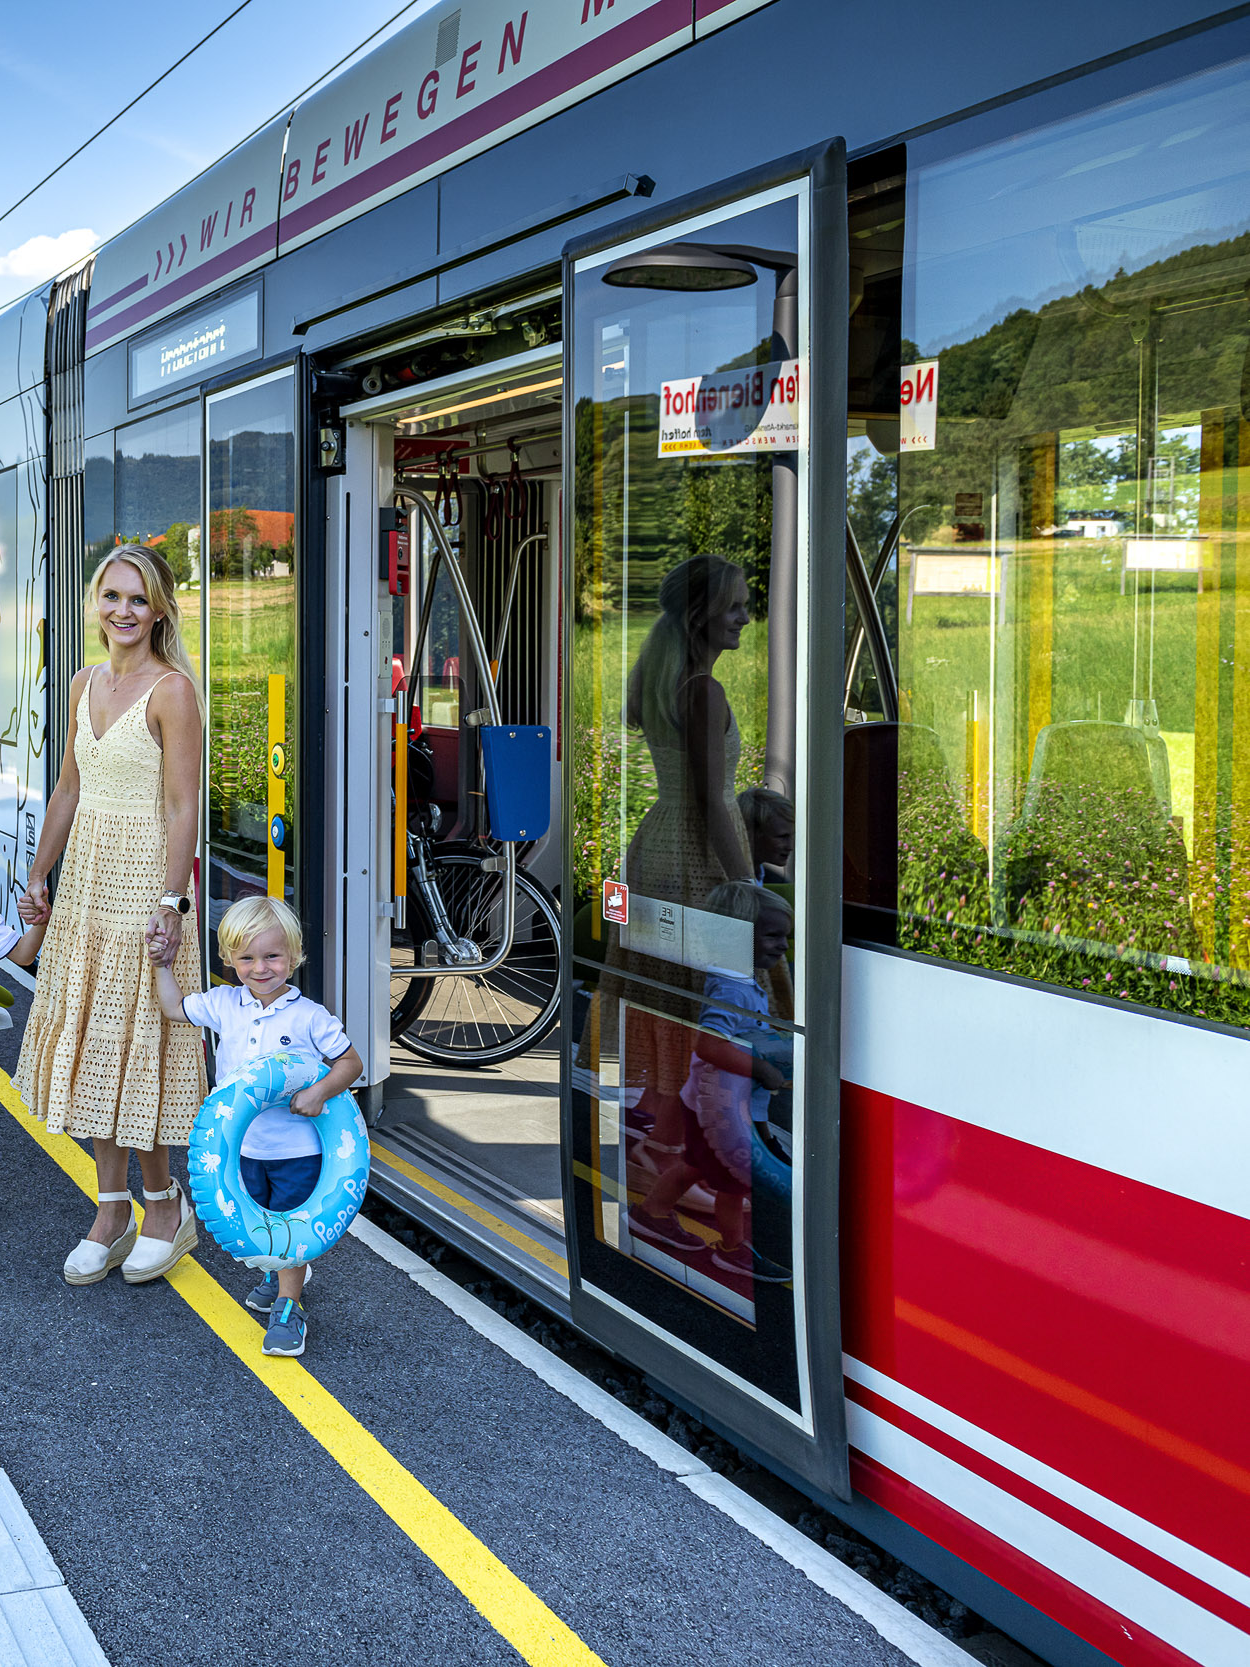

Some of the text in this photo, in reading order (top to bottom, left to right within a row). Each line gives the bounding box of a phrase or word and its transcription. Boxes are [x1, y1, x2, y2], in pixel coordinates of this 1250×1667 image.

[199, 10, 529, 252] WIR BEWEGEN
[313, 1178, 368, 1245] Peppa Pig
